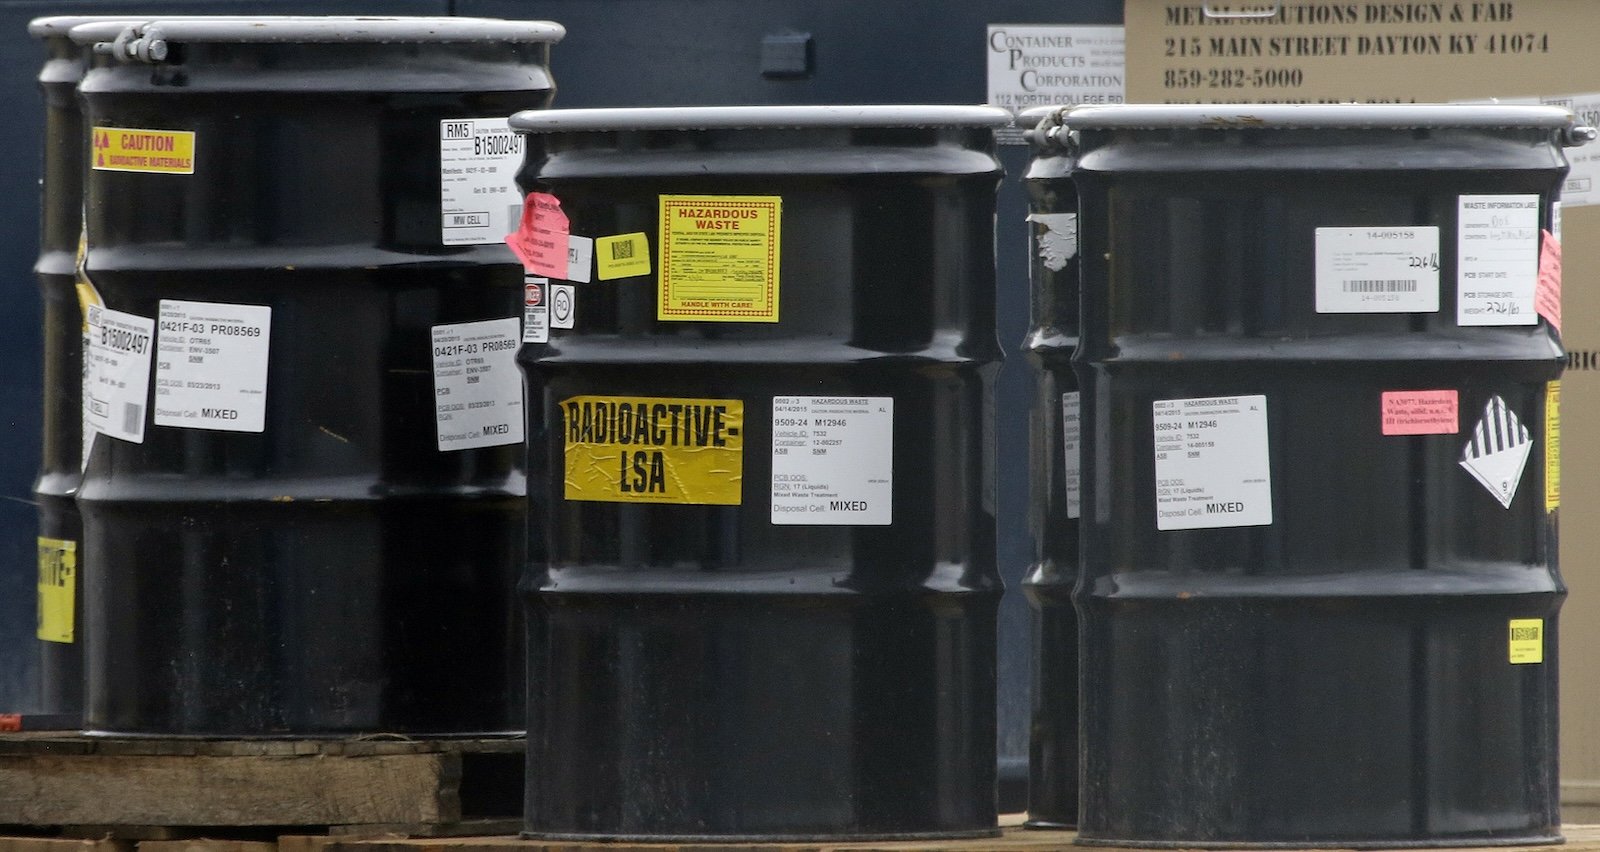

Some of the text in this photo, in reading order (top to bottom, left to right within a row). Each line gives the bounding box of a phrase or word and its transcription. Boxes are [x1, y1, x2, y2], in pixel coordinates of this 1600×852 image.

[1165, 2, 1513, 25] METAL SOLUTIONS DESIGN & FAB
[990, 31, 1073, 53] CONTAINER
[1165, 33, 1550, 57] 215 MAIN STREET DAYTON KY 41074
[1009, 49, 1086, 71] PRODUCTS
[1020, 70, 1122, 92] CORPORATION
[1164, 68, 1304, 89] 859-282-5000
[995, 95, 1012, 104] 112
[1014, 95, 1051, 105] NORTH
[1055, 95, 1104, 105] COLLEGE
[447, 123, 470, 139] RM5
[121, 134, 174, 151] CAUTION
[474, 135, 523, 155] B15002497
[110, 155, 191, 168] RADIOACTIVE MATERIALS
[467, 216, 481, 225] CELL
[679, 209, 759, 220] HAZARDOUS
[696, 220, 740, 230] WASTE
[1367, 232, 1415, 240] 14-005158
[160, 321, 260, 337] 0421F-03 PR08569
[101, 325, 150, 355] B15002497
[435, 340, 516, 358] 0421F-03 PR08569
[201, 408, 238, 420] MIXED
[483, 424, 509, 436] MIXED
[568, 402, 739, 447] RADIOACTIVE-
[774, 419, 847, 427] 9509-24 M12946
[1155, 420, 1218, 431] 9509-24 M12946
[621, 450, 666, 493] LSA
[773, 505, 807, 513] Disposal
[830, 501, 868, 511] MIXED
[1206, 502, 1244, 514] MIXED
